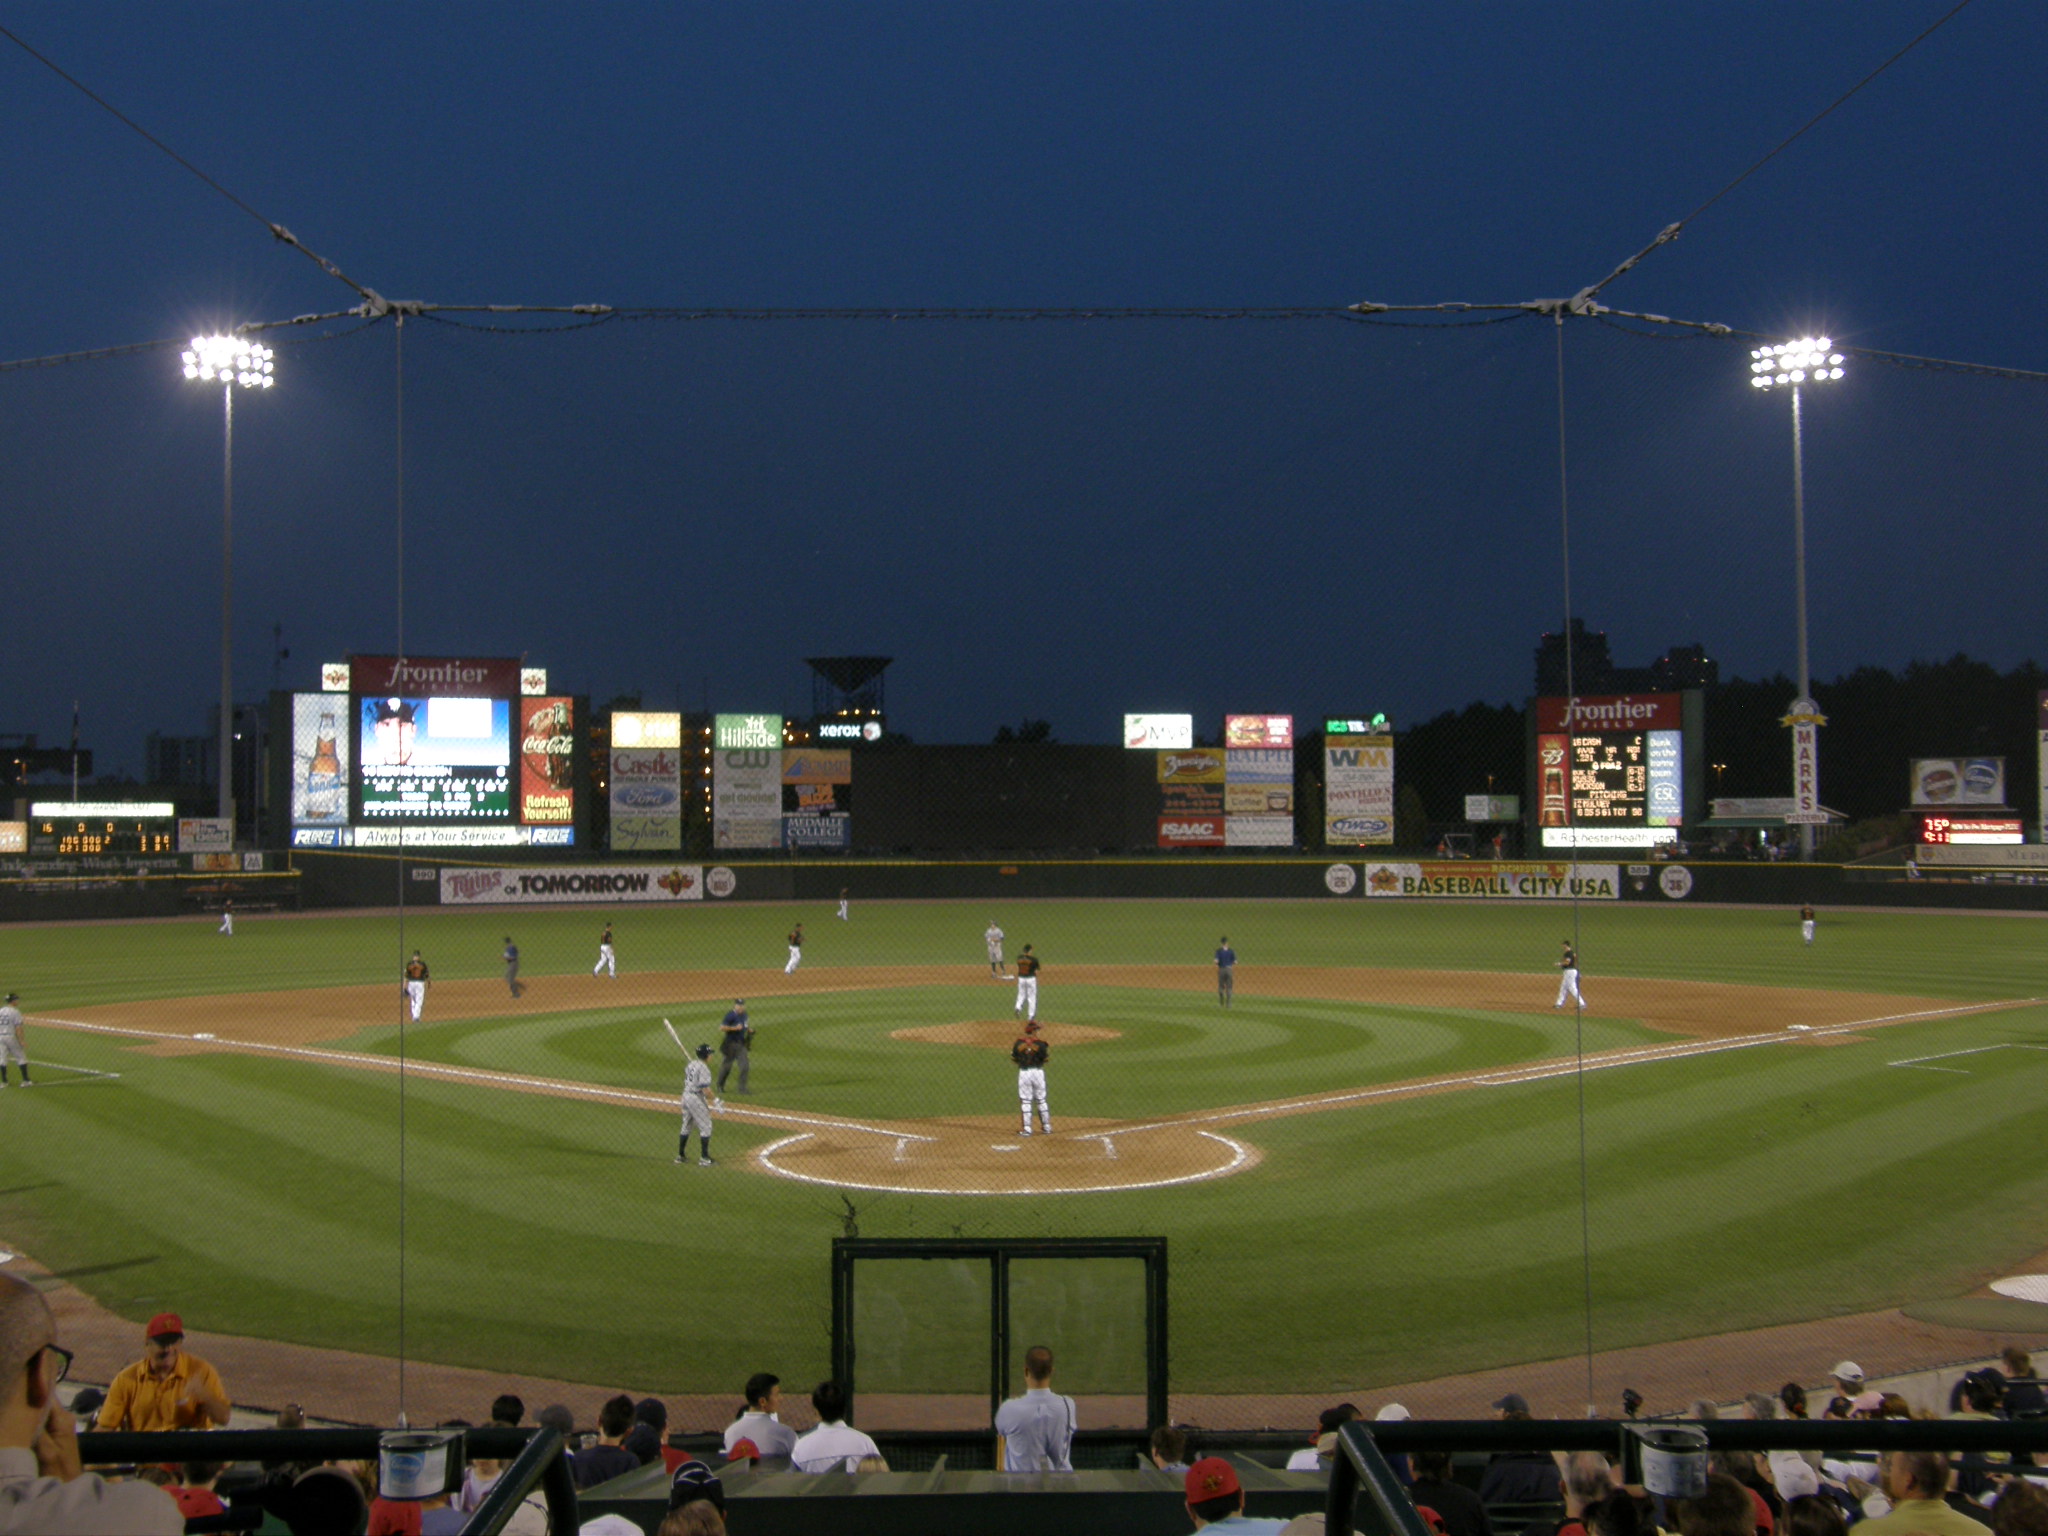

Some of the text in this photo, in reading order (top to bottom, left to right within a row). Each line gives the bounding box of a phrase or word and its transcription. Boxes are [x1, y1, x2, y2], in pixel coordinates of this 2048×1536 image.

[385, 657, 488, 688] frontier
[1560, 697, 1658, 727] frontier
[819, 724, 860, 738] xerox
[1582, 721, 1634, 729] FIELD
[721, 727, 777, 748] Hillside
[1149, 726, 1189, 740] MVP
[1228, 750, 1292, 763] RALPH
[1330, 750, 1389, 768] WM
[613, 752, 677, 776] Castle
[802, 759, 850, 773] SUMMIT
[1798, 731, 1812, 811] MARKS
[625, 789, 665, 805] Ford
[1654, 787, 1676, 800] ESL
[526, 795, 570, 808] Refresh
[523, 807, 572, 820] Yourself!
[1786, 814, 1827, 822] PIZZERIA
[787, 817, 843, 827] MEDAILLE
[1161, 822, 1214, 836] ISAAC
[363, 830, 506, 844] Always at Your Service
[616, 819, 669, 849] Sylvan
[787, 828, 842, 837] COLLEGE
[447, 871, 502, 898] Twins
[518, 873, 649, 895] TOMORROW
[1403, 877, 1613, 895] BASEBALL CITY USA
